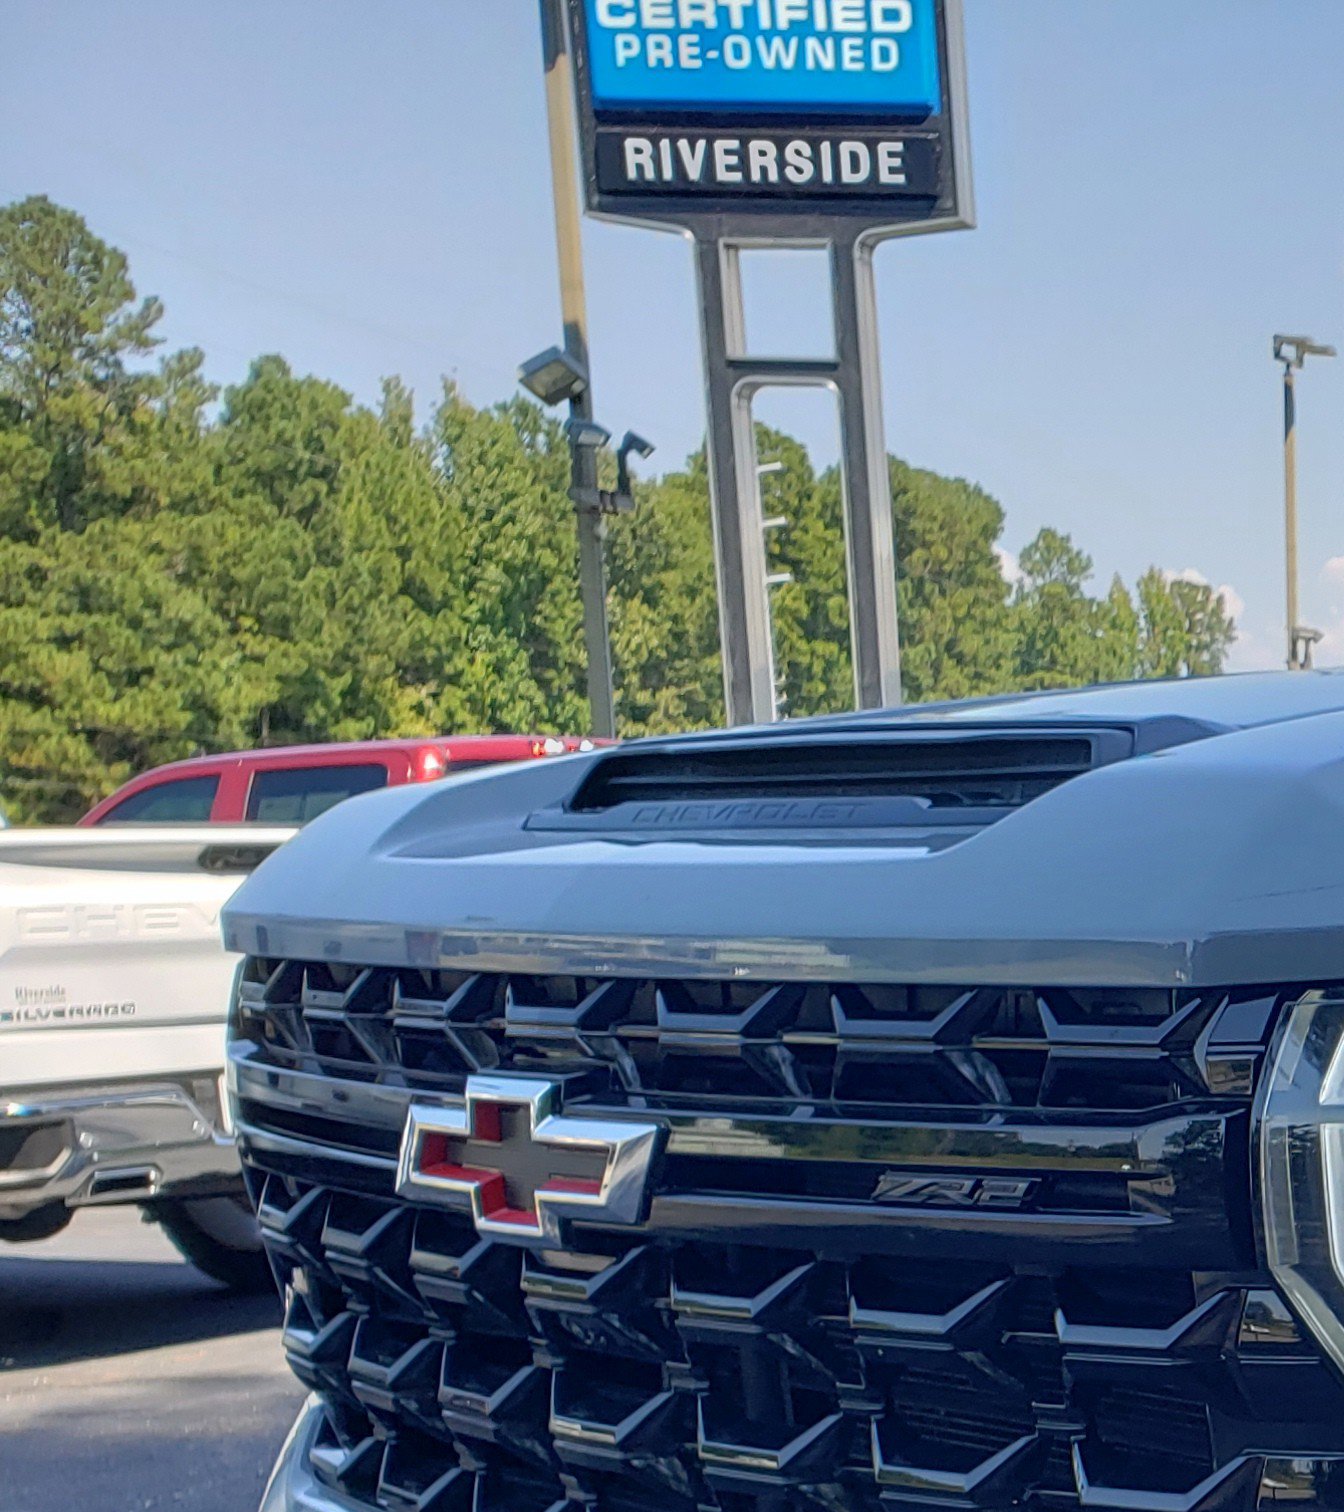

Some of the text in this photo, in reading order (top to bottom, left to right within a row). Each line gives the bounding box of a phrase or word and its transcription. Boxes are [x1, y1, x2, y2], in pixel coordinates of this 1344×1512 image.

[596, 0, 914, 33] CERTIFIED
[614, 34, 901, 73] PRE-OWNED
[623, 136, 907, 185] RIVERSIDE
[631, 801, 872, 824] CHEVROLET
[870, 1170, 1044, 1208] ZR2
